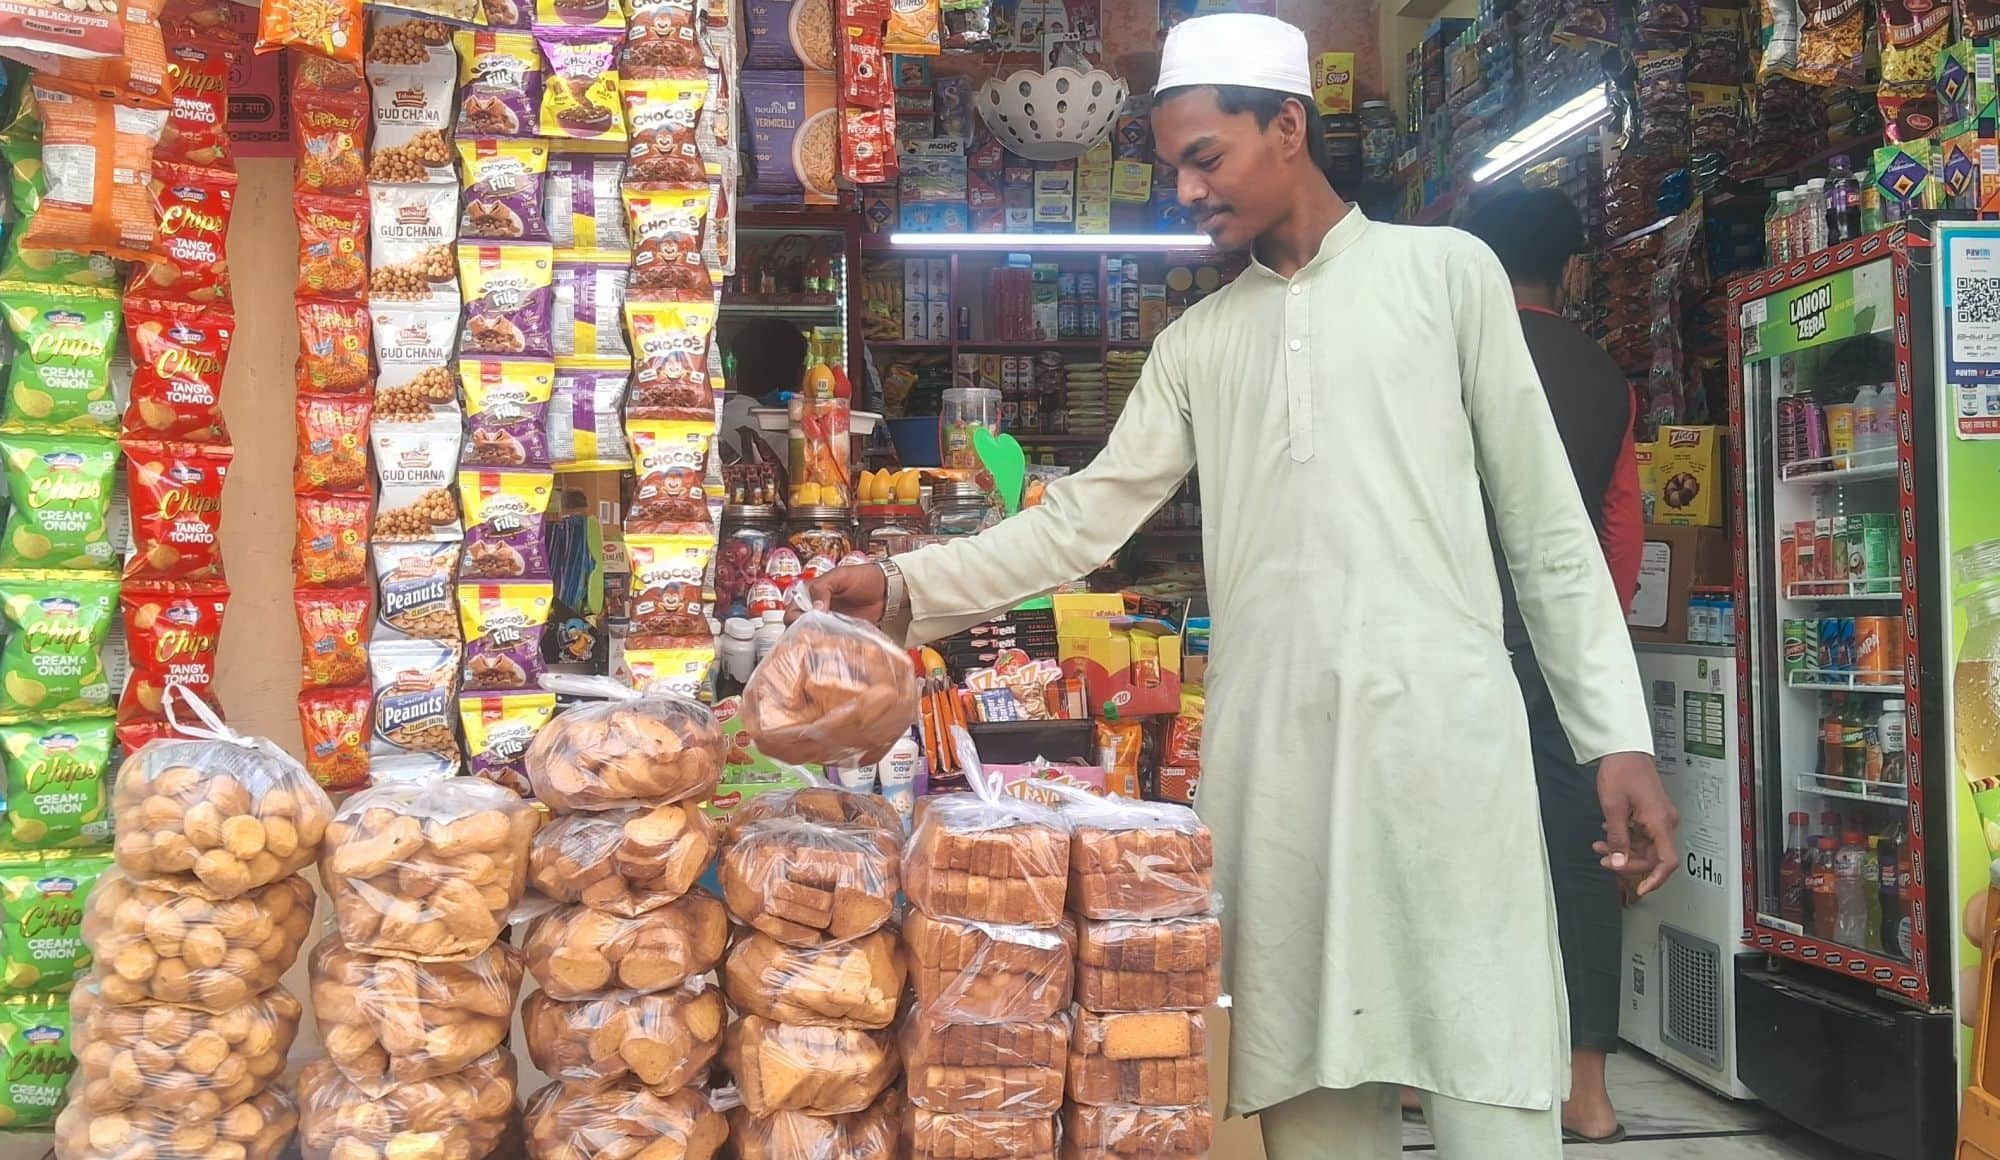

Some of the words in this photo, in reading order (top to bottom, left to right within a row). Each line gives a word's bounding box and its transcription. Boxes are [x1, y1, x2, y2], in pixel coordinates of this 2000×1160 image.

[27, 8, 37, 16] &
[38, 10, 73, 23] BLACK
[72, 14, 109, 28] PEPPER
[564, 56, 605, 68] CHOCO
[167, 64, 224, 94] Chips
[486, 69, 513, 87] Fills
[173, 97, 212, 114] TANGY
[755, 102, 788, 115] nourish
[170, 109, 217, 124] TOMATO
[378, 108, 399, 120] GUD
[402, 108, 440, 121] CHANA
[633, 108, 694, 127] CHOCOS
[755, 117, 795, 129] VERMICELLI
[488, 177, 516, 190] Fills
[160, 206, 223, 235] Chips
[639, 215, 699, 235] CHOCOS
[381, 225, 404, 237] GUD
[406, 225, 444, 237] CHANA
[175, 237, 213, 252] TANGY
[171, 247, 217, 263] TOMATO
[493, 289, 520, 307] Fills
[1790, 284, 1832, 323] LAHORI
[31, 332, 105, 365] Chips
[643, 335, 702, 353] CHOCOS
[380, 347, 404, 359] GUD
[406, 347, 444, 359] CHANA
[157, 348, 220, 380] Chips
[40, 366, 86, 379] CREAM
[86, 370, 95, 379] &
[45, 378, 89, 389] ONION
[171, 381, 211, 396] TANGY
[166, 391, 214, 406] TOMATO
[642, 450, 703, 469] CHOCOS
[382, 470, 405, 481] GUD
[407, 469, 446, 481] CHANA
[160, 488, 221, 520] Chips
[37, 511, 84, 522] CREAM
[83, 512, 92, 521] &
[44, 521, 87, 532] ONION
[174, 521, 211, 534] TANGY
[494, 516, 521, 533] Fills
[170, 531, 214, 543] TOMATO
[640, 566, 702, 585] CHOCOS
[385, 581, 444, 613] Peanuts
[493, 628, 520, 645] Fills
[990, 624, 1017, 636] Treat
[156, 630, 217, 663] Chips
[991, 638, 1017, 649] Treat
[32, 655, 79, 666] CREAM
[79, 657, 87, 666] &
[37, 665, 82, 676] ONION
[168, 664, 206, 675] TANGY
[164, 673, 210, 685] TOMATO
[384, 696, 443, 728] Peanuts
[496, 741, 523, 758] Fills
[25, 759, 97, 793] Chips
[33, 793, 80, 805] CREAM
[79, 793, 88, 803] &
[40, 802, 82, 815] ONION
[27, 938, 74, 951] CREAM
[73, 938, 82, 948] &
[33, 948, 77, 960] ONION
[9, 1084, 54, 1098] CREAM
[53, 1087, 62, 1098] &
[12, 1094, 58, 1107] ONION
